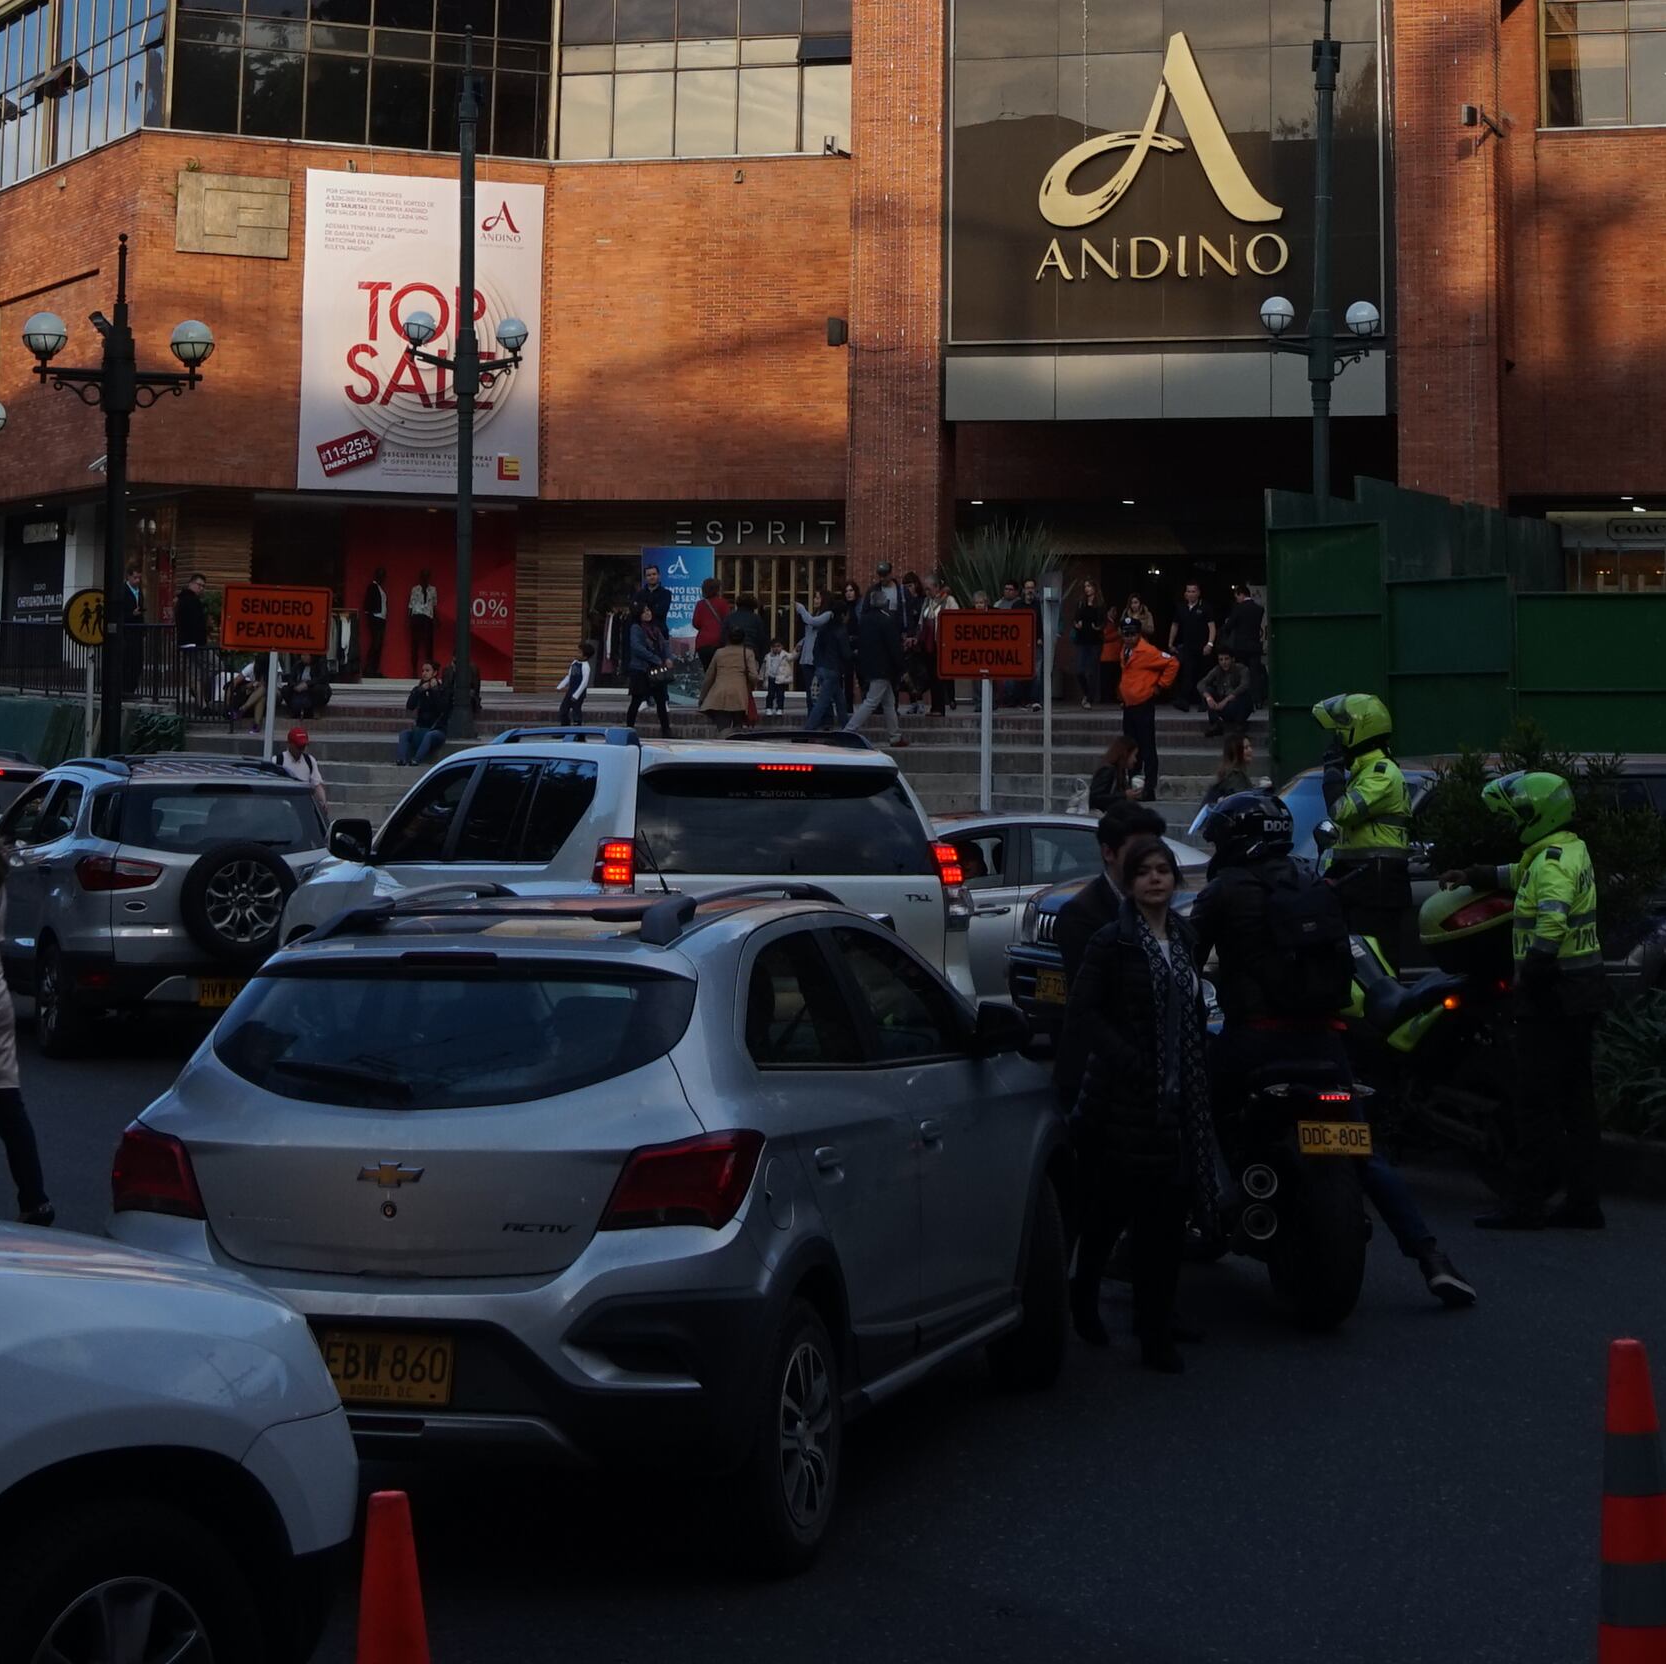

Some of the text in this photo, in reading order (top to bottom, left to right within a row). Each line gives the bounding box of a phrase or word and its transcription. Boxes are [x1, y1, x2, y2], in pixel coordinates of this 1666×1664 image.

[480, 233, 521, 243] ANDINO
[1035, 233, 1291, 283] ANDINO
[358, 281, 486, 345] TOP
[344, 343, 495, 410] SALE
[346, 438, 363, 454] 25
[324, 458, 348, 471] ENERO
[675, 520, 837, 545] ESPRIT
[240, 598, 314, 617] SENDERO
[470, 598, 509, 618] 0%
[236, 621, 316, 641] PEATONAL
[954, 624, 1020, 641] SENDERO
[950, 649, 1023, 666] PEATONAL
[502, 1222, 578, 1234] ACTIV
[349, 1384, 390, 1397] BOGOTA
